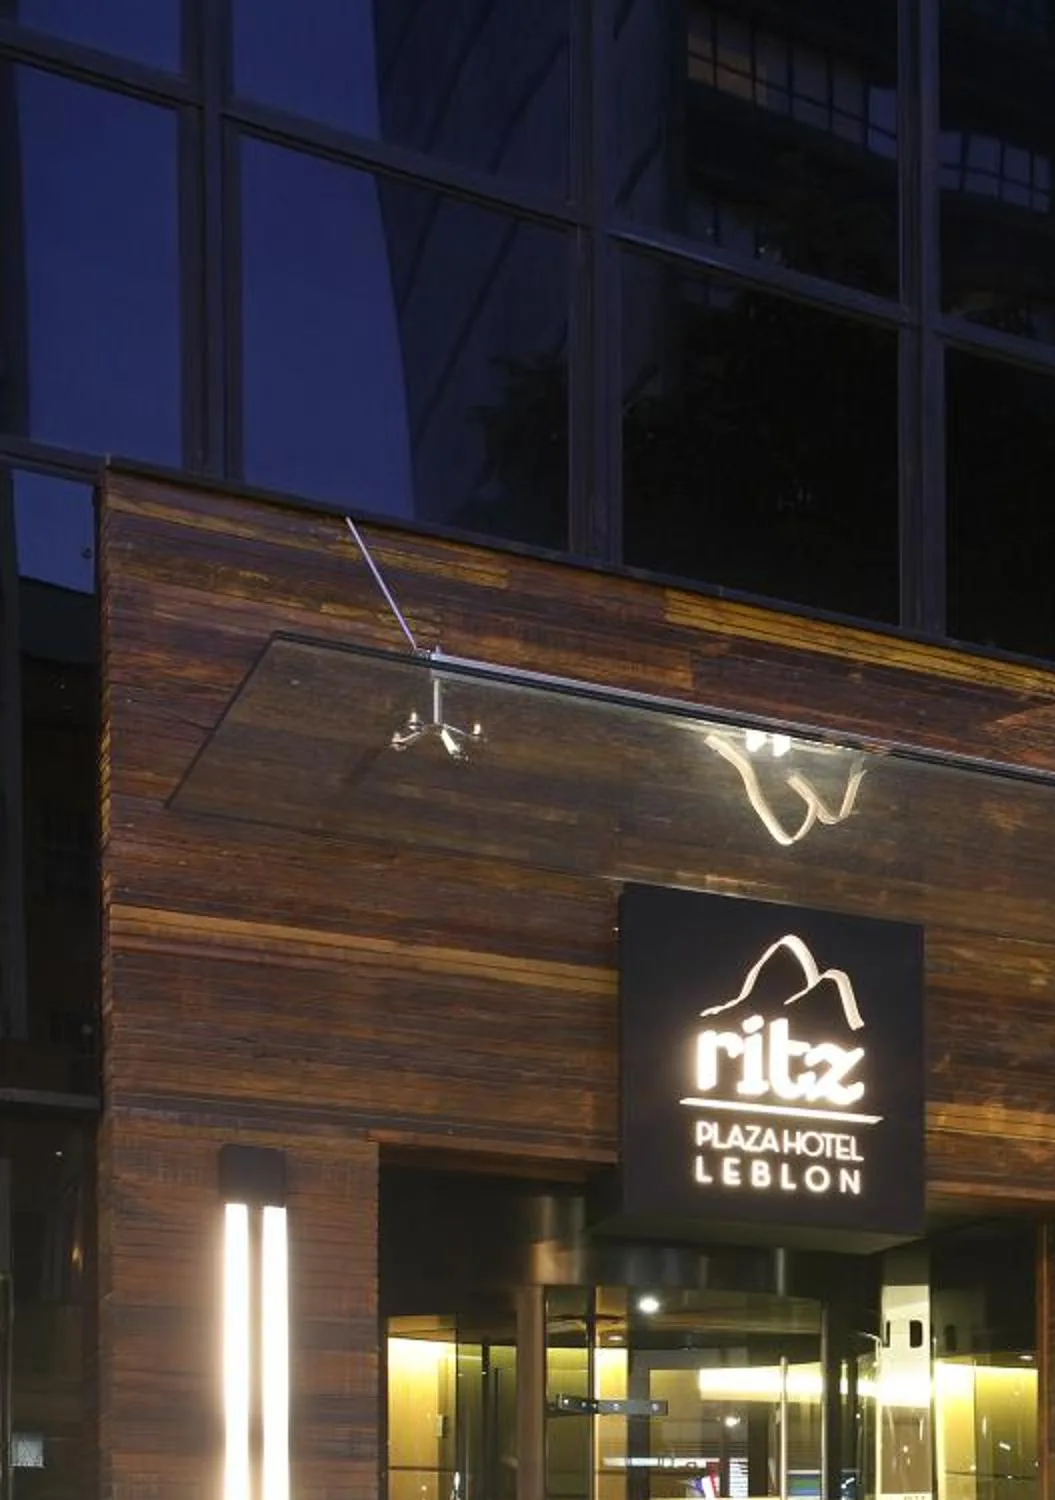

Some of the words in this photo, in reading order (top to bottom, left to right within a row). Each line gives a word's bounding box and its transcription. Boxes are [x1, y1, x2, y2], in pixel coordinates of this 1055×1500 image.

[695, 1014, 866, 1106] ritz
[695, 1120, 780, 1153] PLAZA
[782, 1130, 865, 1162] HOTEL
[695, 1155, 862, 1195] LEBLON
